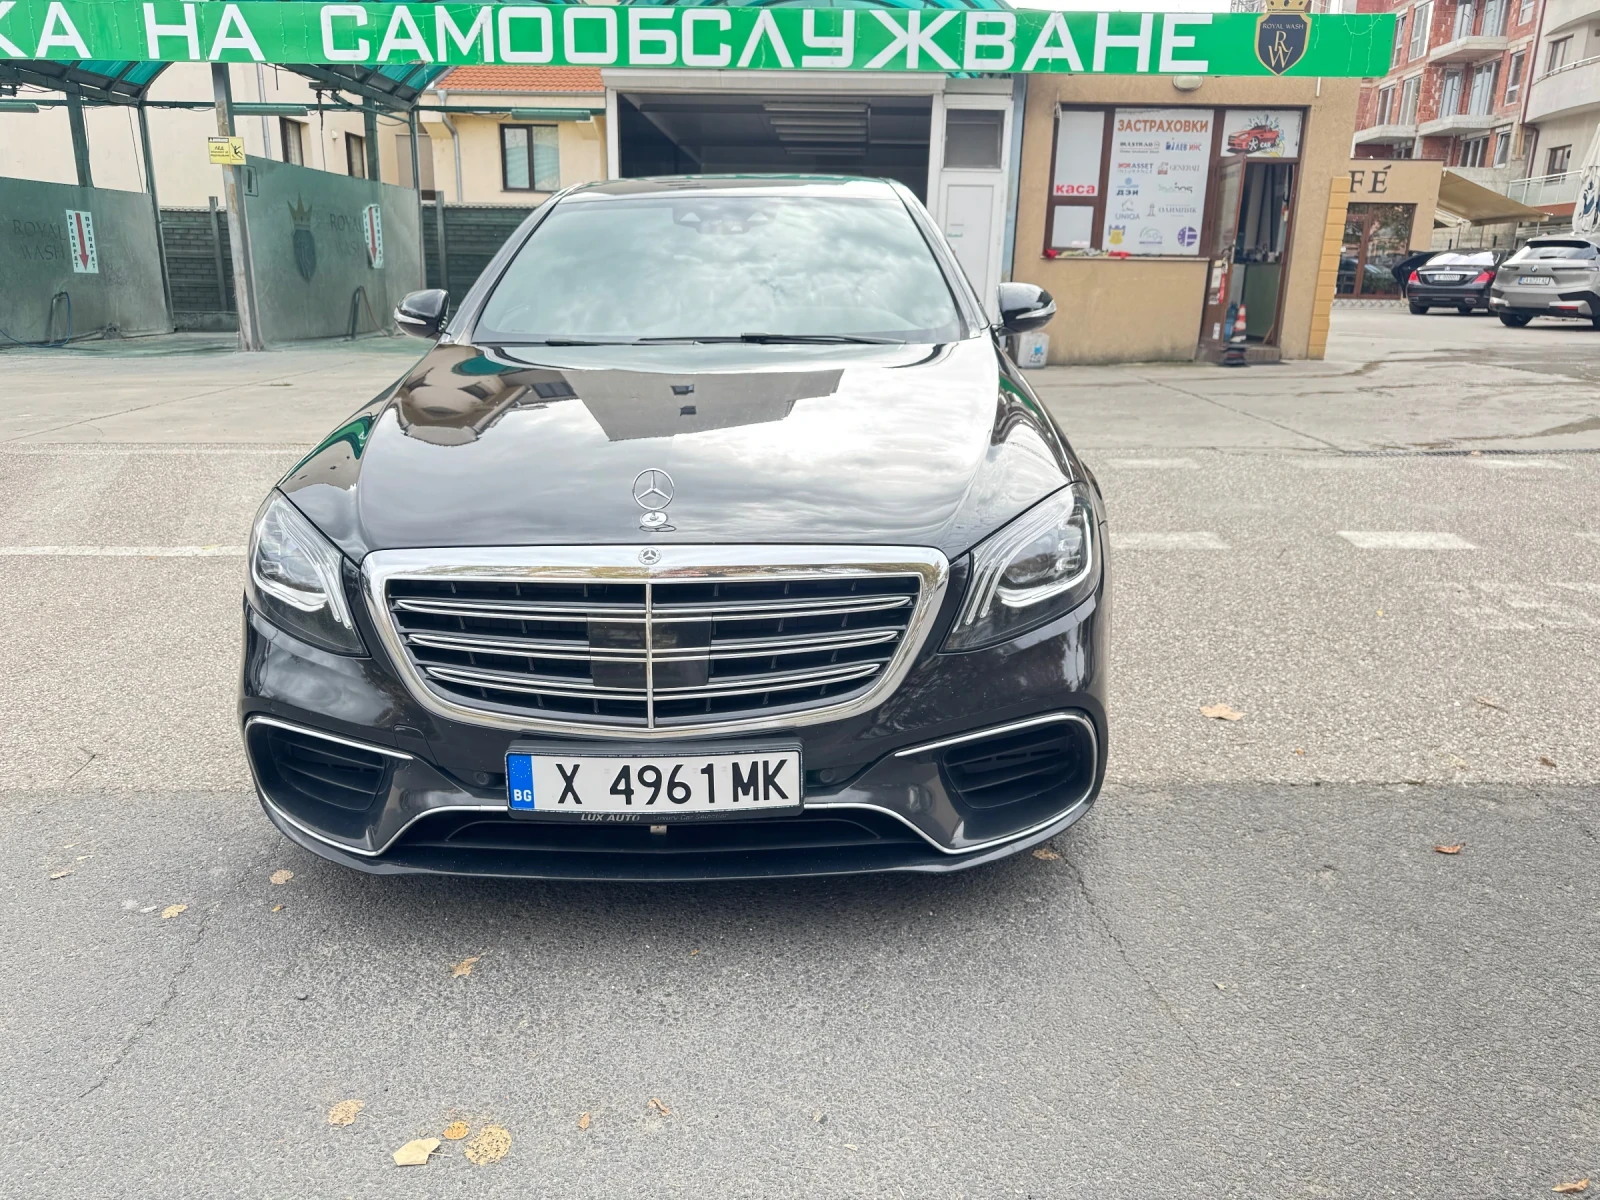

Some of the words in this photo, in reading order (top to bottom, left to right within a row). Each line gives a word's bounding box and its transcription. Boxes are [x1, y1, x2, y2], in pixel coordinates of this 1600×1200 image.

[143, 3, 265, 61] НА
[320, 4, 1213, 73] САМООБСЛУЖВАНЕ
[1117, 119, 1209, 133] ЗАСТРАХОВКИ
[1056, 184, 1096, 195] каса
[13, 219, 67, 240] ROYAL
[330, 213, 364, 234] ROYAL
[68, 214, 79, 268] ПРЕПАРАТ
[85, 216, 96, 269] ПРЕПАРАТ
[20, 243, 65, 261] WASH
[513, 789, 532, 801] BG
[555, 763, 583, 804] X
[609, 763, 715, 805] 4961
[731, 759, 789, 803] MK
[580, 813, 605, 822] LUX
[606, 814, 640, 822] AUTO
